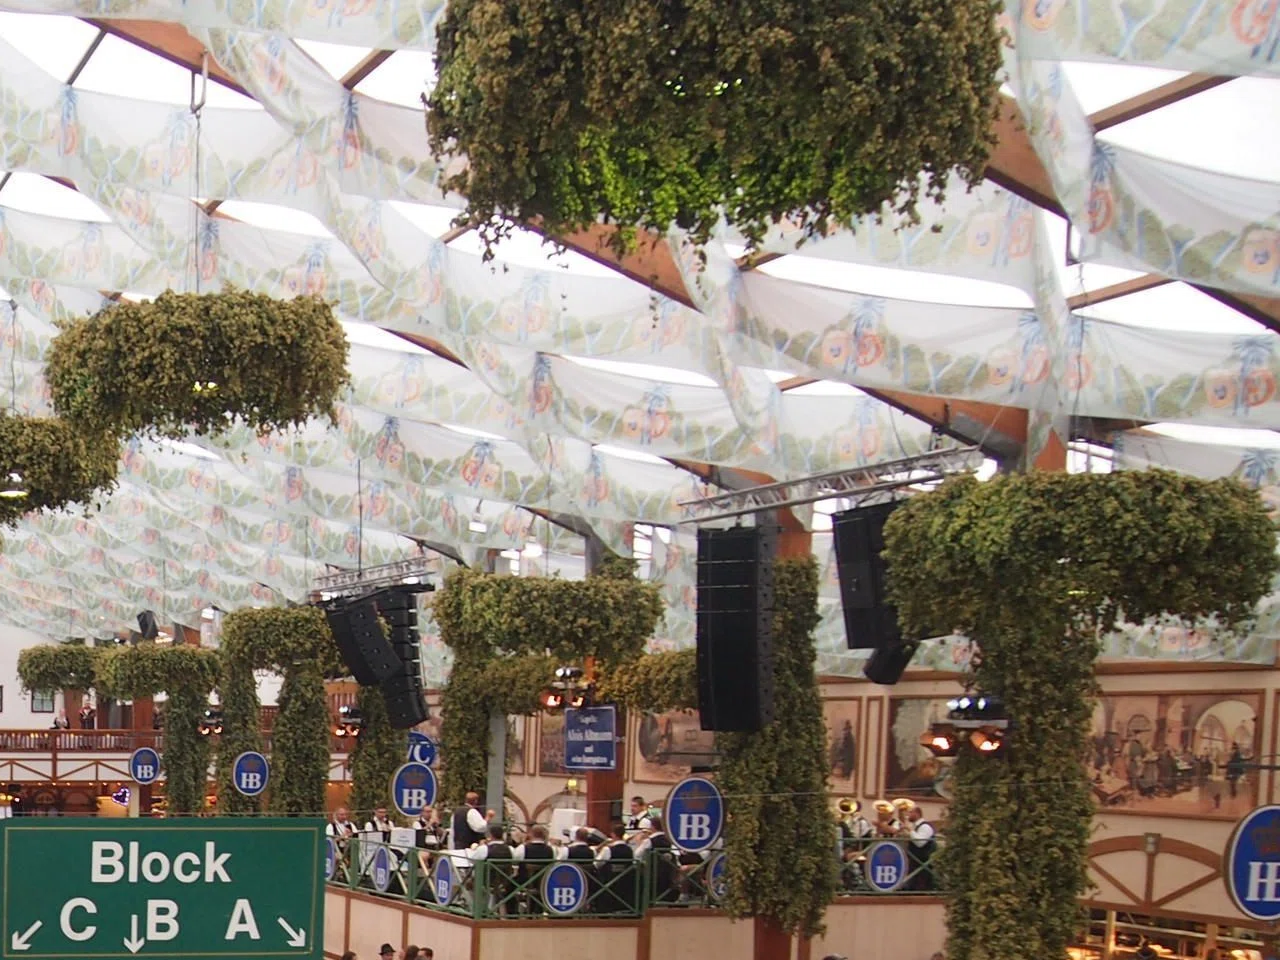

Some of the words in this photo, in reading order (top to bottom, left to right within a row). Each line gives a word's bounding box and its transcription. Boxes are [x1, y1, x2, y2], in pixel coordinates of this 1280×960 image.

[137, 765, 154, 779] HB
[240, 772, 262, 789] HB
[402, 788, 427, 809] HB
[678, 813, 711, 841] HB
[91, 840, 232, 884] Block
[875, 865, 897, 884] HB
[553, 887, 576, 906] HB
[59, 897, 98, 942] C
[146, 899, 180, 941] B
[224, 899, 261, 940] A
